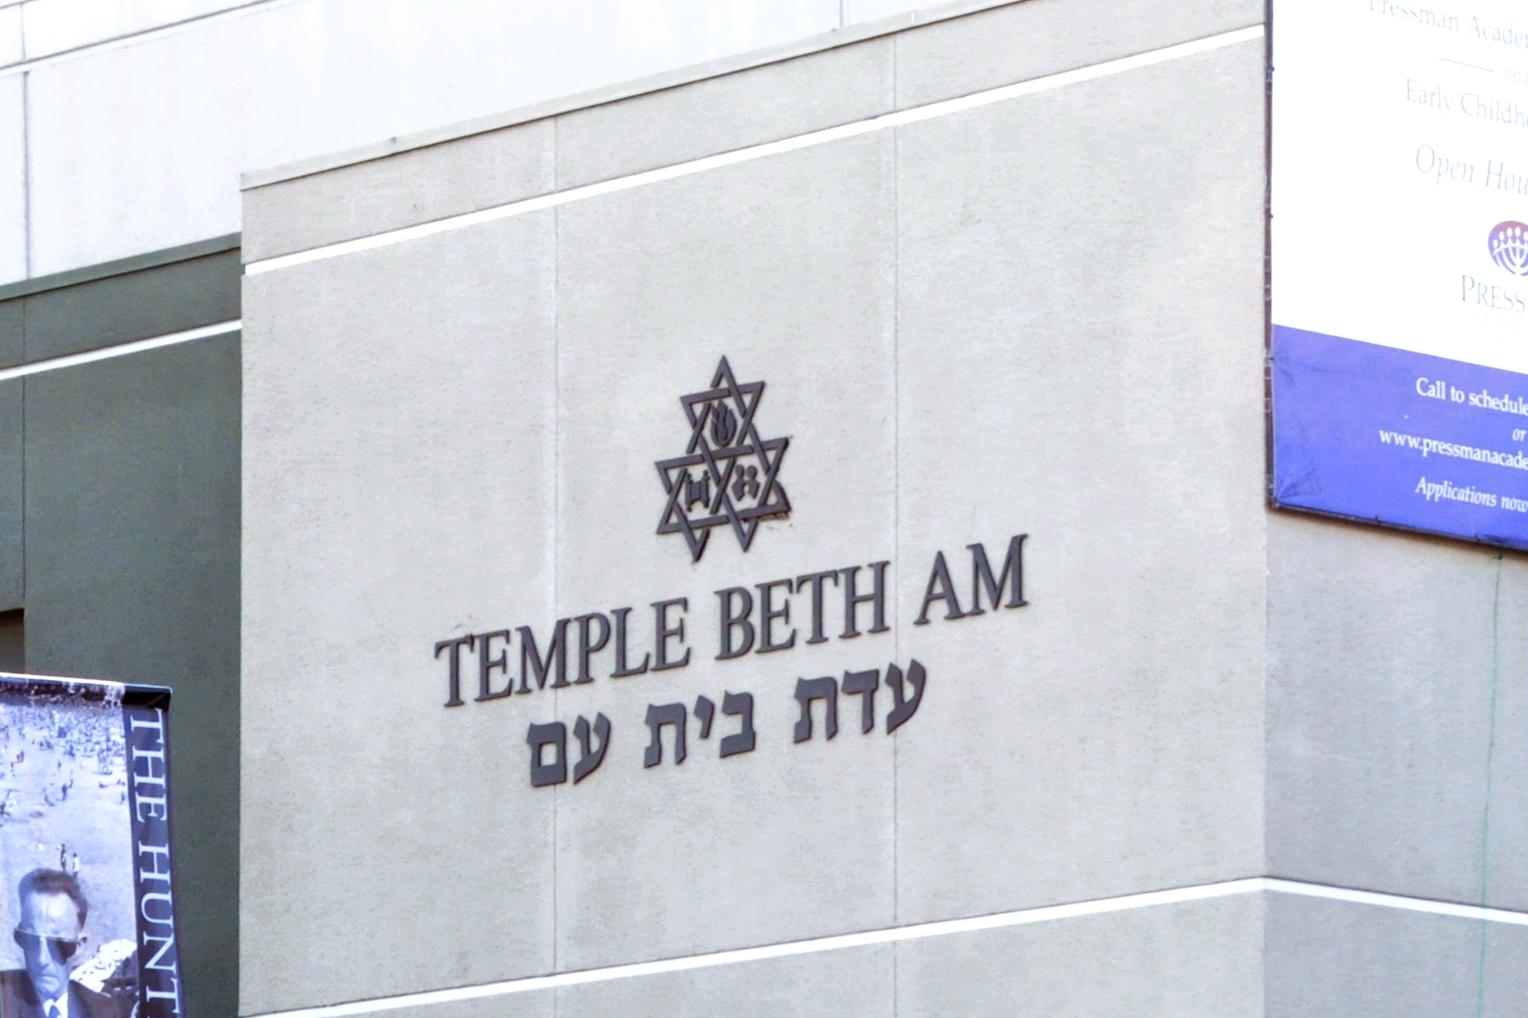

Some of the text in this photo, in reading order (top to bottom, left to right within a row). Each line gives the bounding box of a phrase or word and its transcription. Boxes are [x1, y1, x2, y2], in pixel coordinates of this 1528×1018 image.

[1406, 78, 1451, 117] Early
[1416, 144, 1474, 184] Open
[1415, 377, 1447, 400] Call
[1450, 386, 1465, 404] to
[1512, 427, 1527, 442] or
[1415, 476, 1497, 509] Applications
[1500, 496, 1528, 514] now
[434, 533, 1030, 708] TEMPLE BETH AM
[526, 657, 927, 788] עדת בית עם
[130, 708, 168, 824] THE
